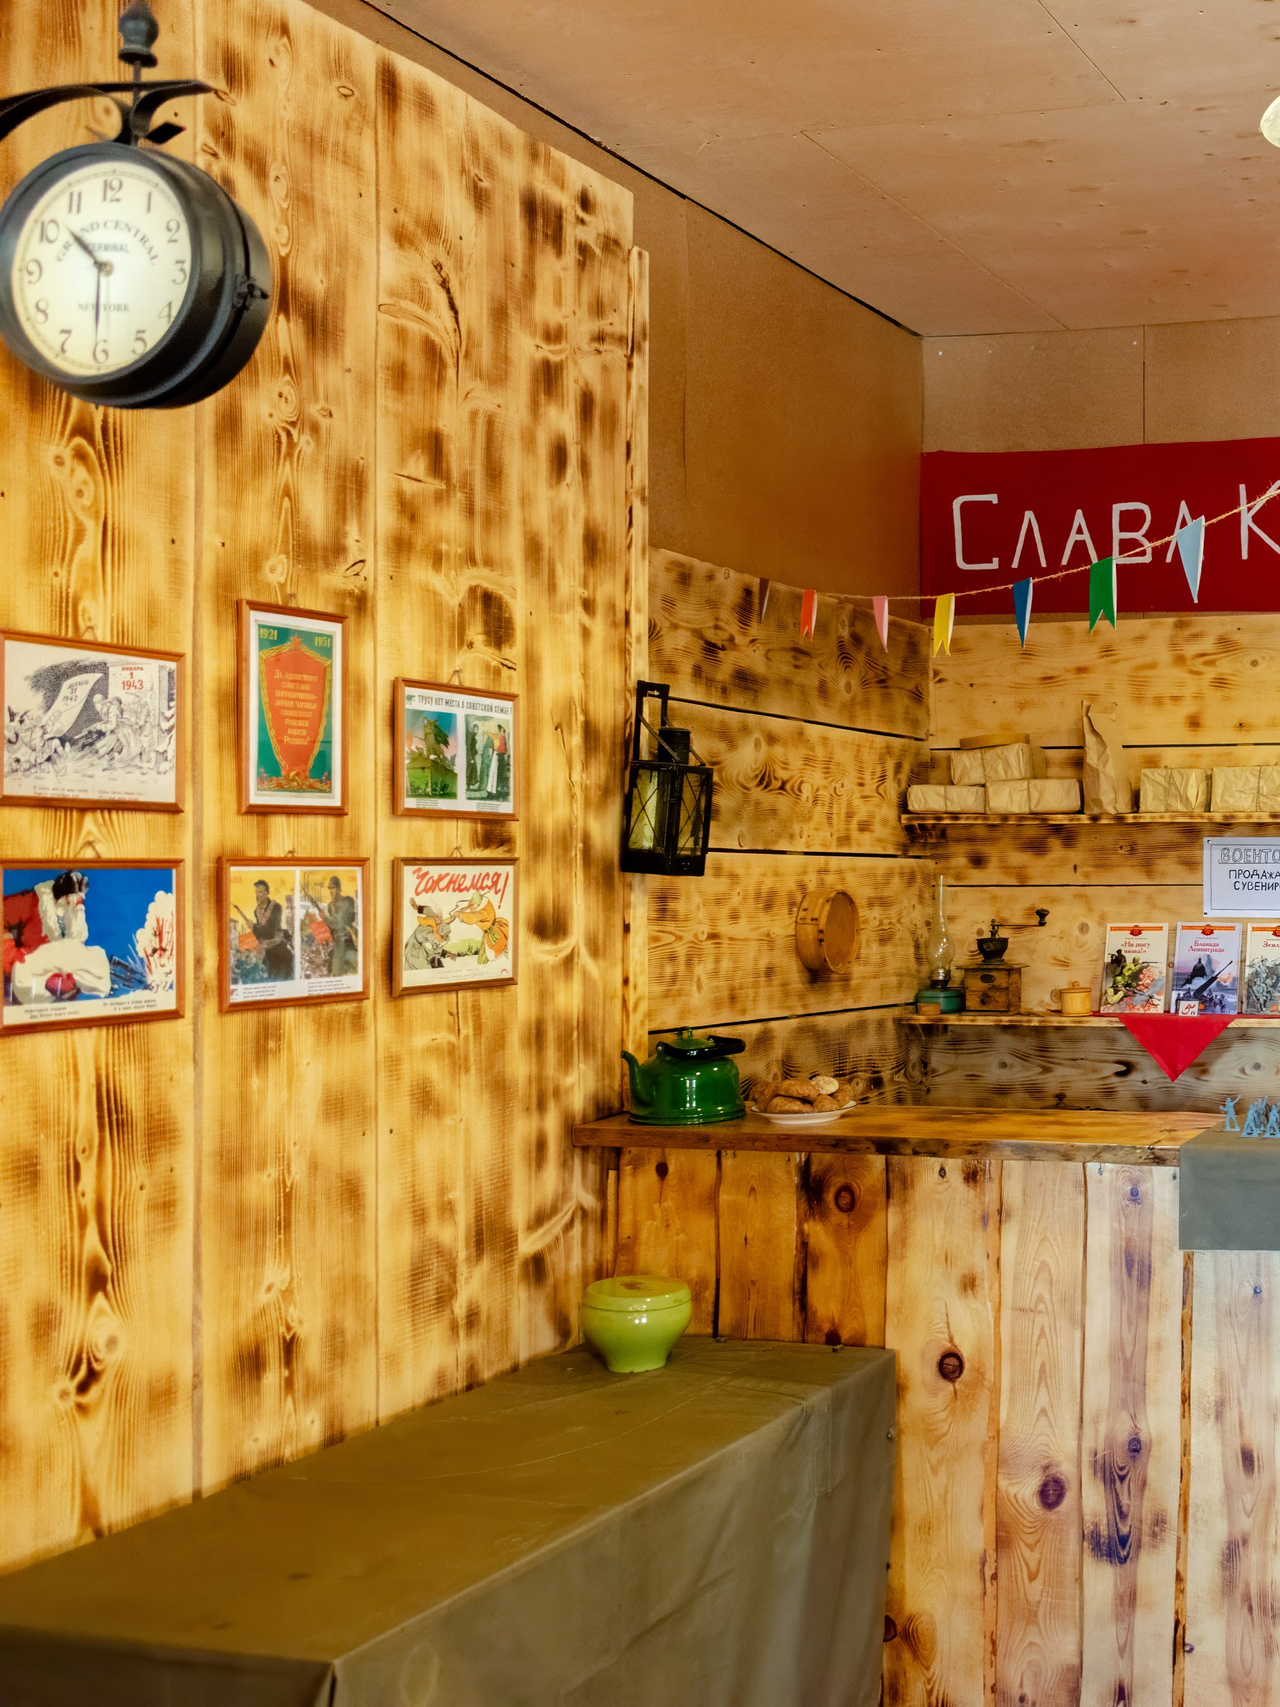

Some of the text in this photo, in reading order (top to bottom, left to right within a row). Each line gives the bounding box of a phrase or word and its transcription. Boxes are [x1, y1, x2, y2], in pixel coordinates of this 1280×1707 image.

[68, 191, 82, 215] 11
[102, 178, 123, 203] 12
[146, 191, 153, 214] 1
[39, 218, 61, 244] 10
[56, 219, 159, 266] GRND CENTRAL
[166, 218, 181, 243] 2
[26, 259, 43, 284] 9
[172, 260, 187, 285] 3
[35, 299, 49, 324] 8
[102, 303, 130, 312] YORK
[158, 301, 176, 324] 4
[59, 329, 73, 355] 7
[92, 339, 110, 364] 6
[131, 329, 148, 356] 5
[952, 493, 1205, 571] СЛАВА
[260, 628, 278, 640] 1921
[314, 636, 331, 649] 1951
[121, 680, 144, 691] 1943
[129, 671, 134, 679] 1
[412, 867, 510, 909] Чокнемся!
